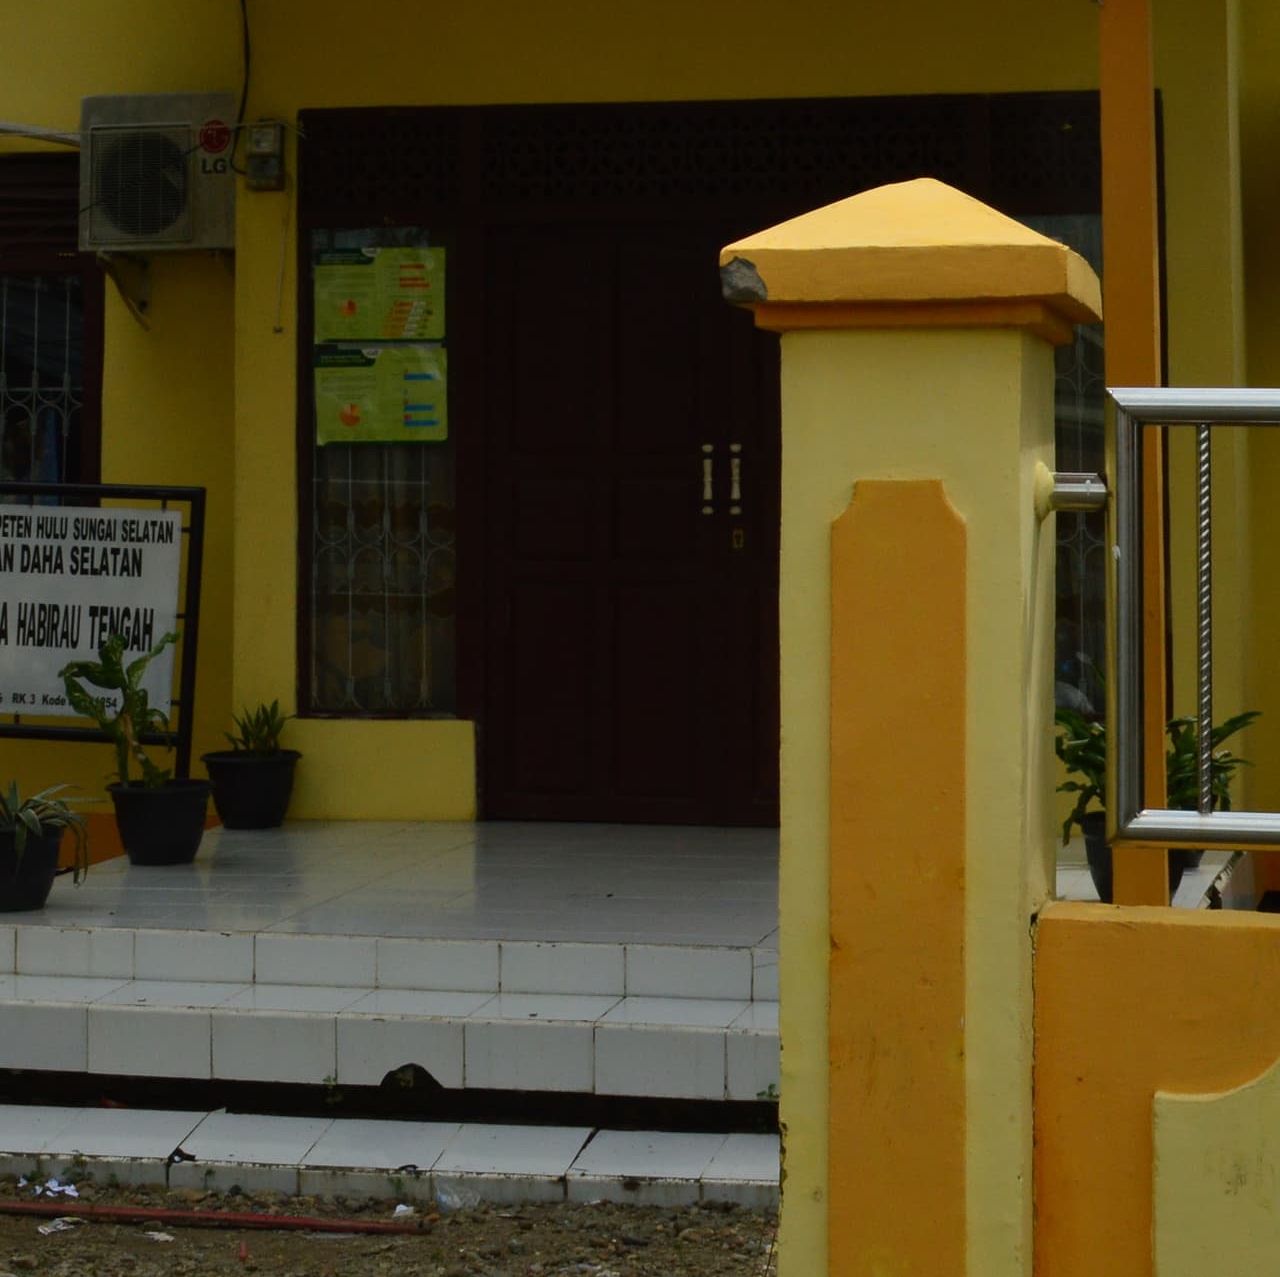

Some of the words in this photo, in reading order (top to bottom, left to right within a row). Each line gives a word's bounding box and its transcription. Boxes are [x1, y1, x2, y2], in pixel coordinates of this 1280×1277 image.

[201, 157, 227, 174] LG
[37, 517, 68, 539] HULU
[73, 520, 117, 542] SUNGAI
[121, 520, 174, 544] SELATAN
[21, 543, 65, 574] DAHA
[70, 546, 143, 577] SELATAN
[16, 602, 82, 649] HABIRAU
[89, 605, 154, 652] TENGAH
[42, 694, 66, 706] Kode
